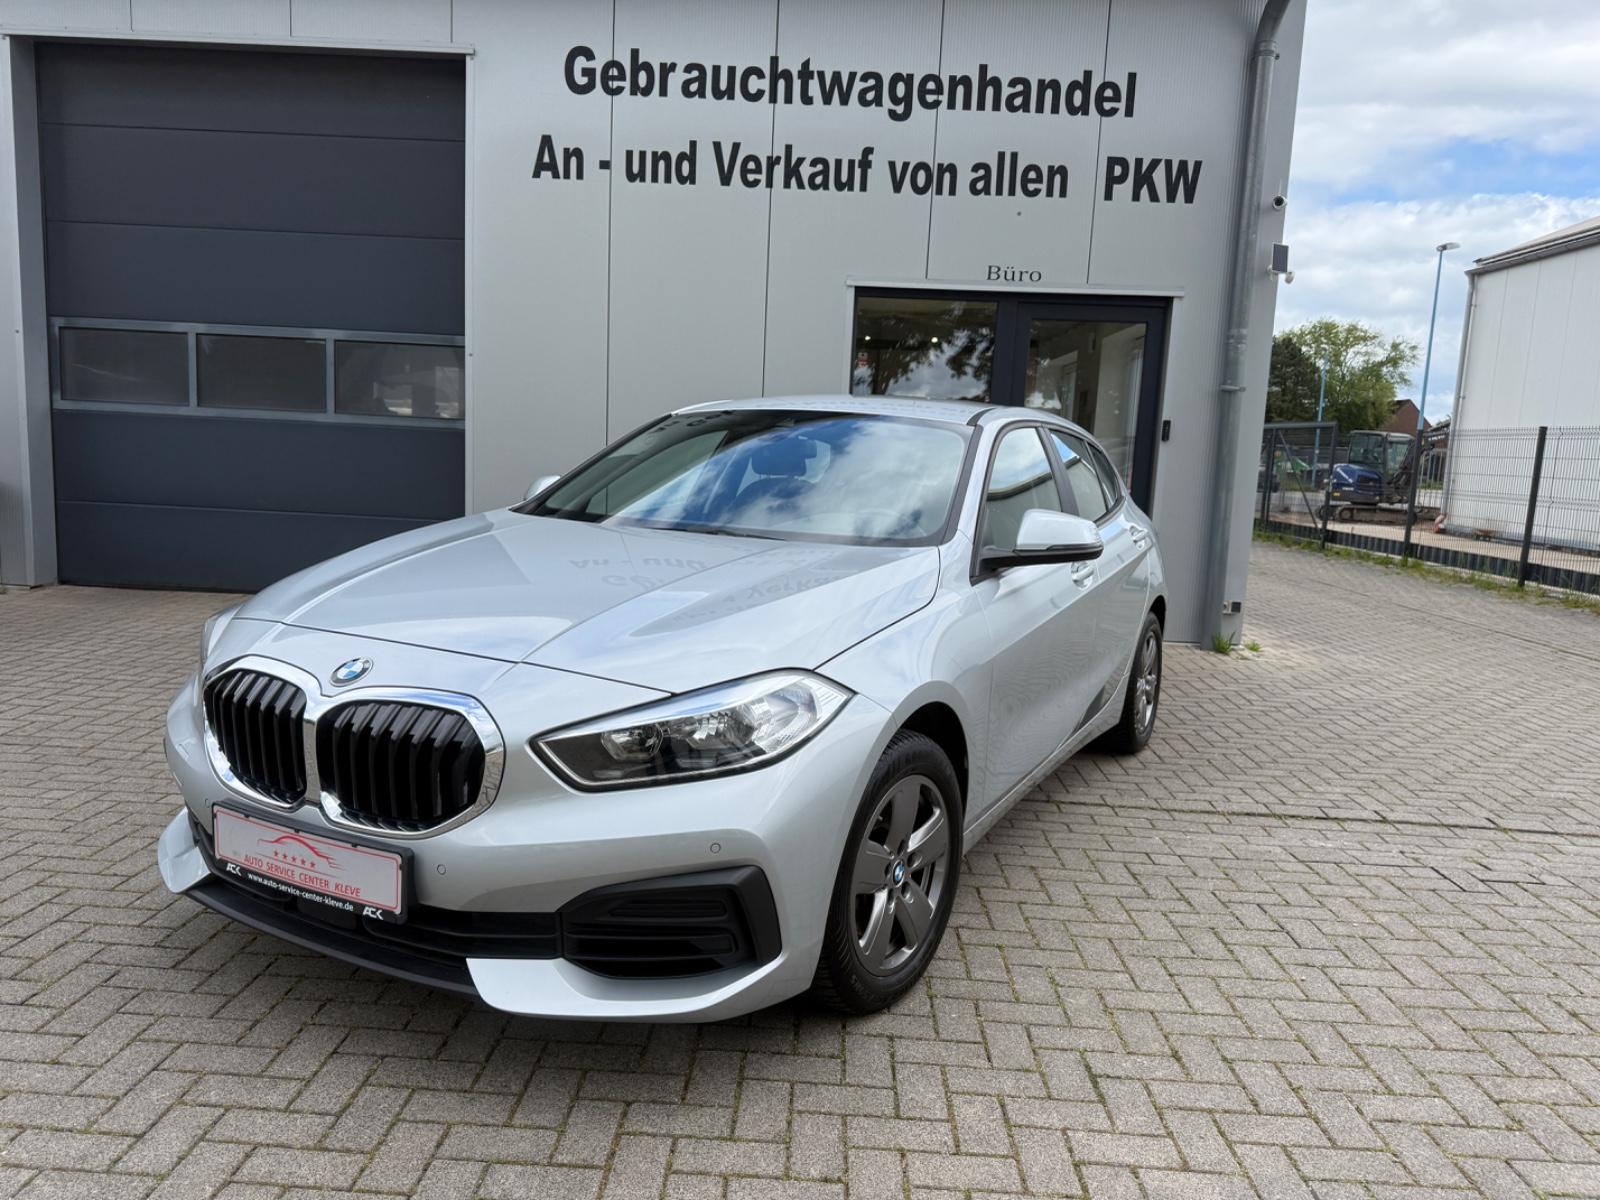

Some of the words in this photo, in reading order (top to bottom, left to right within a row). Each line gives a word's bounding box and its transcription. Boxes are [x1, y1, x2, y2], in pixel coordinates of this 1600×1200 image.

[564, 45, 1137, 121] Gebrauchtwagenhandel
[532, 134, 584, 180] An
[625, 140, 697, 185] und
[712, 141, 875, 193] Verkauf
[888, 160, 958, 197] von
[969, 151, 1069, 198] allen
[1104, 156, 1203, 204] PKW
[986, 264, 1042, 282] Büro
[244, 854, 263, 868] AUTO
[266, 861, 296, 880] SERVICE
[299, 872, 329, 888] CENTER
[335, 882, 361, 897] KLEVE
[247, 872, 354, 912] www.auto-service-center-kleve.de
